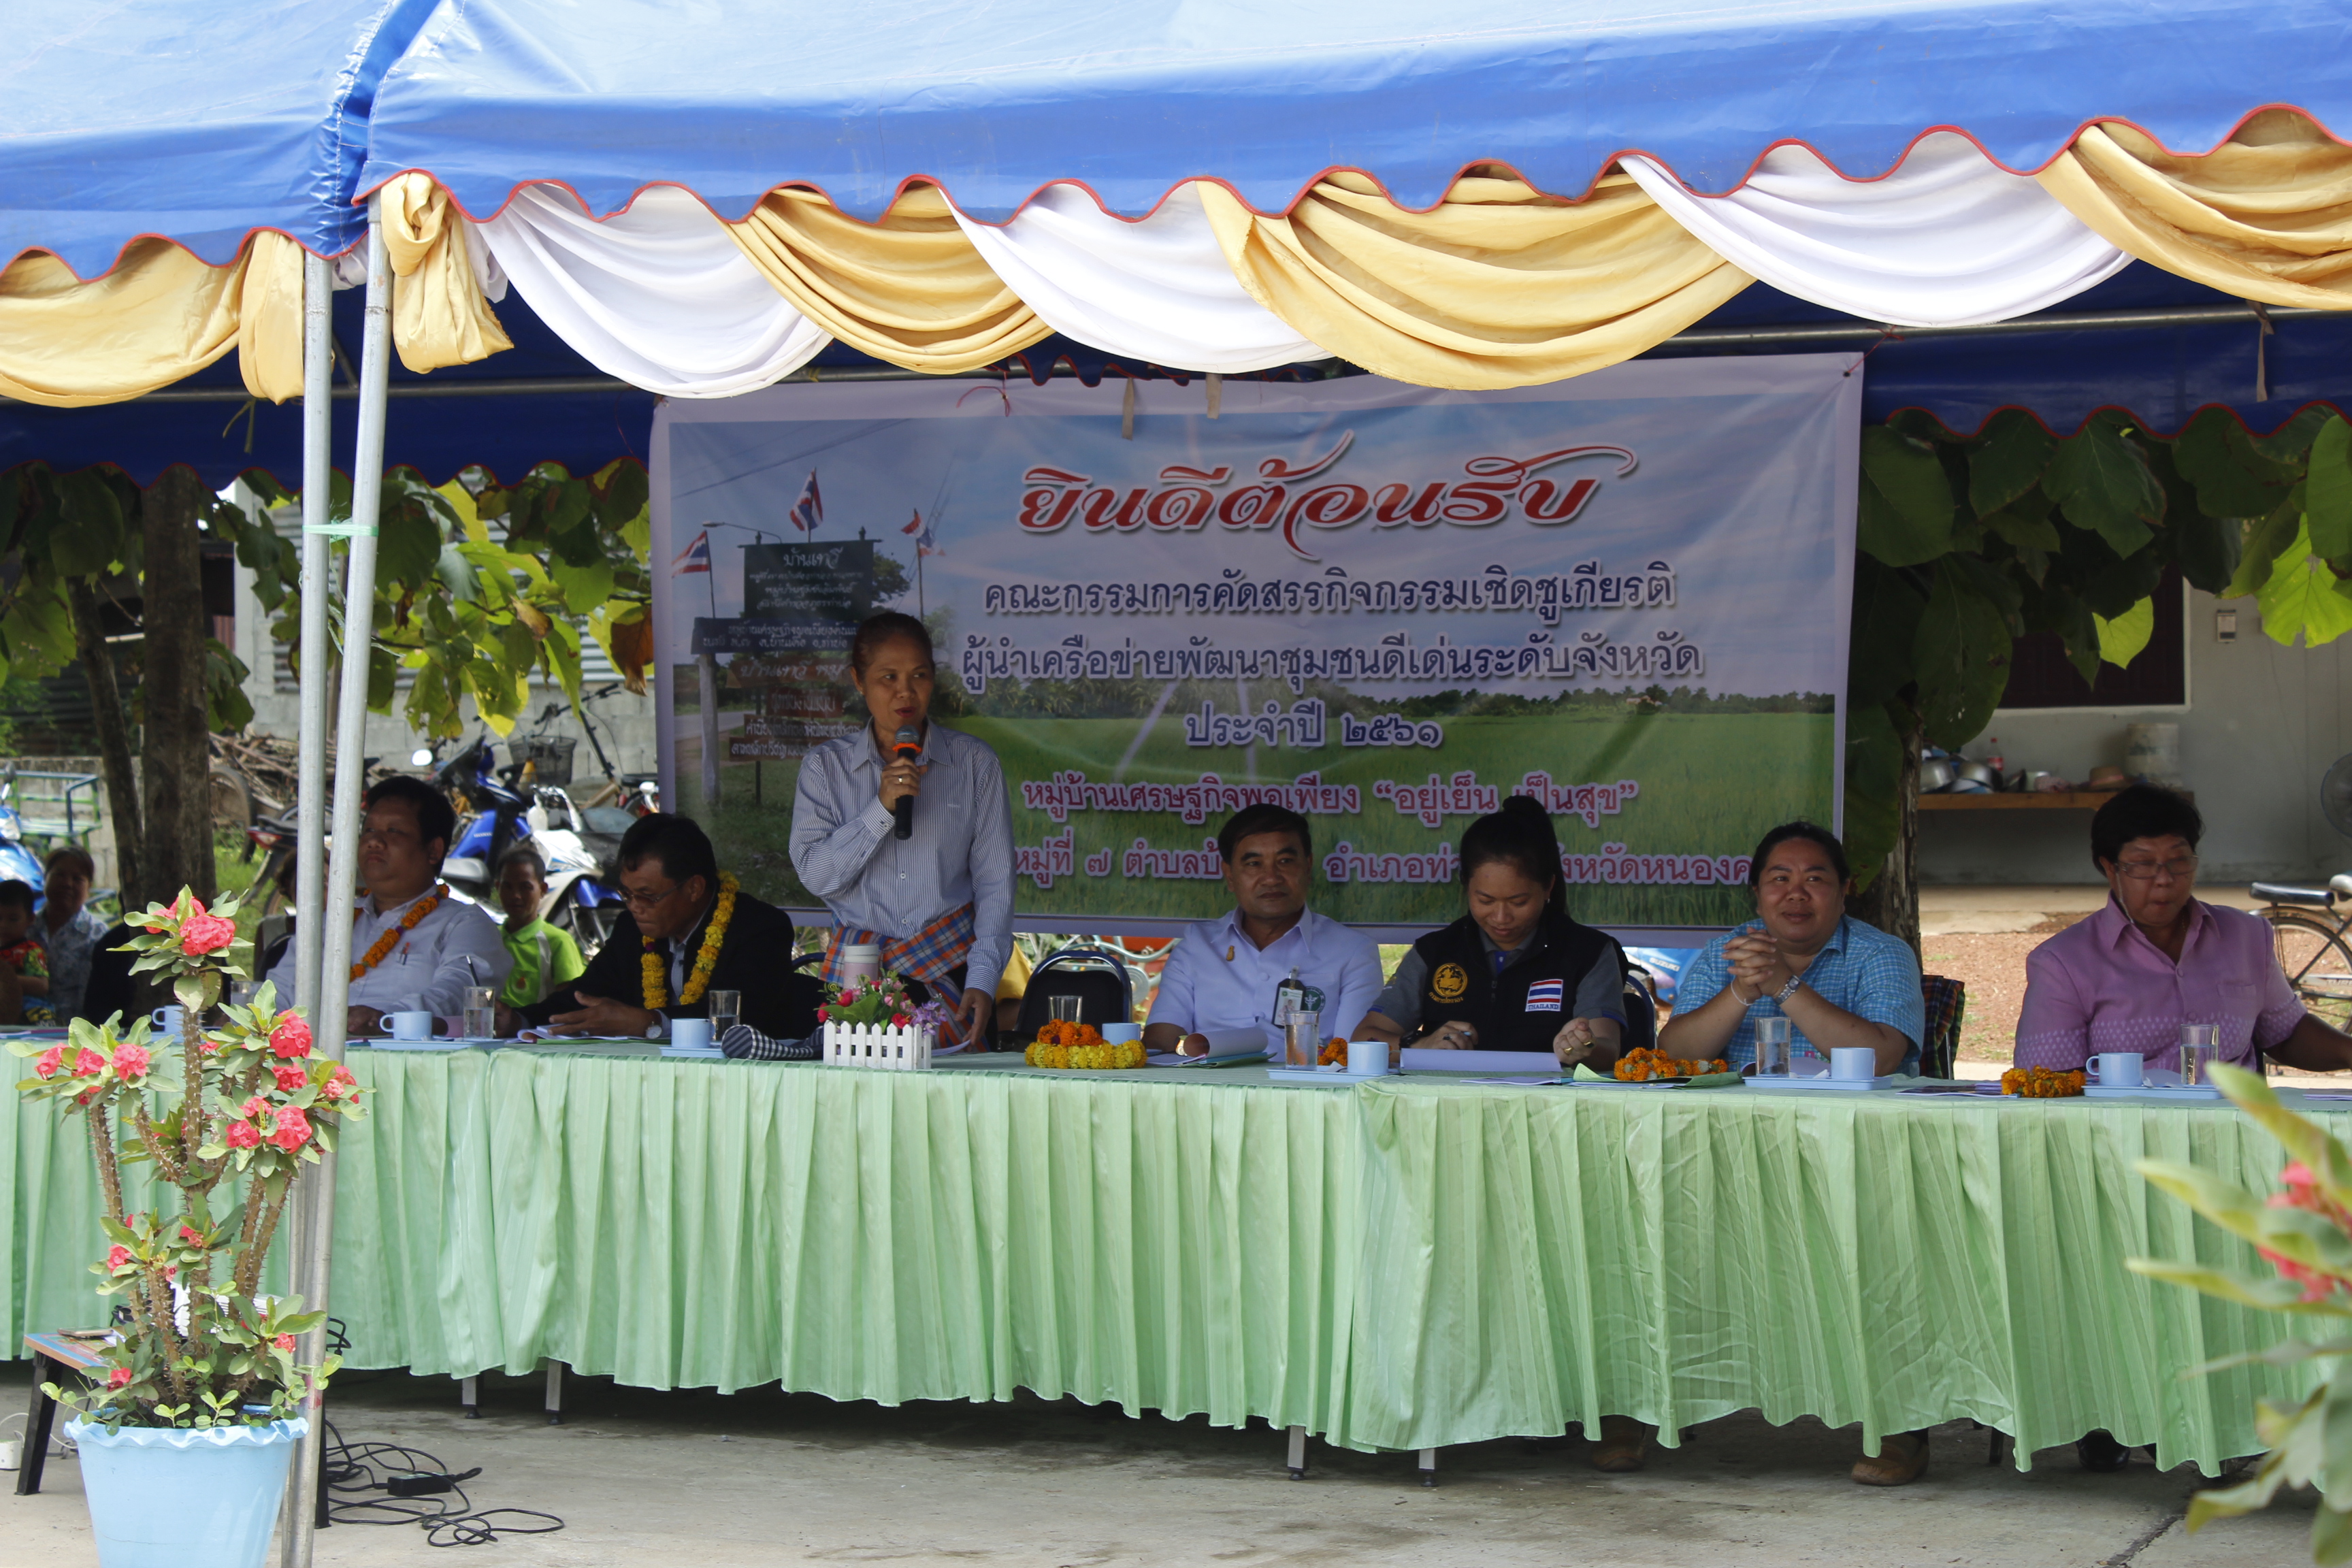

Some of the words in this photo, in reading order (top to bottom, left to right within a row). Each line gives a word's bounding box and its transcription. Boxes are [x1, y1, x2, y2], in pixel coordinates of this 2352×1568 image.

[1018, 430, 1634, 557] ยินดีต้อนรับ
[985, 560, 1671, 621] คณะกรรมการคัดสรรกิจกรรมเชิดชูเกียรติ
[962, 630, 1699, 691] ผู้นำเครือข่ายพัฒนาชุมชนดีเด่นระดับจังหวัด
[1186, 699, 1322, 744] ประจำปี
[1342, 715, 1441, 745] ๒๕๖๑
[1023, 773, 1358, 821] หมู่บ้านเศรษฐกิจพอเพียง
[1087, 850, 1109, 872] ๗
[1125, 840, 1220, 875] ตำบลบ้
[1648, 957, 1681, 973] SUZUKI
